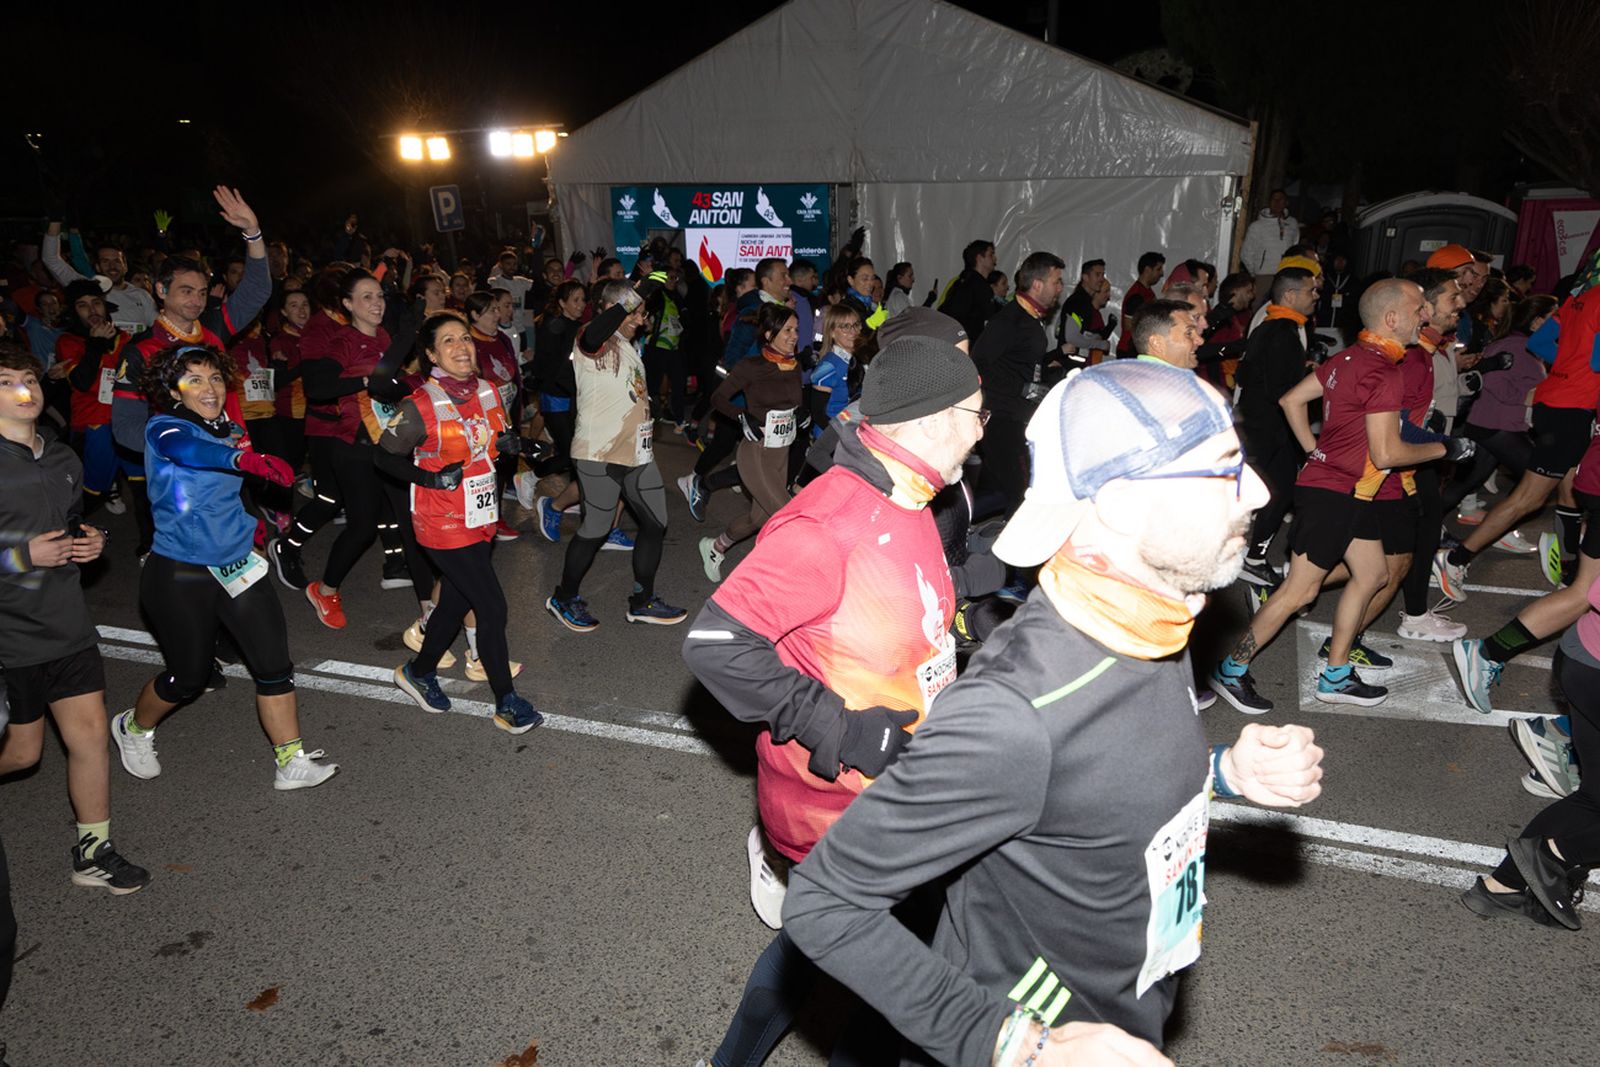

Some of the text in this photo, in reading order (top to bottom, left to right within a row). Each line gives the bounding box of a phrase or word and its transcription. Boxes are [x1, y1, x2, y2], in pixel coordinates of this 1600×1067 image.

[438, 191, 456, 225] P
[692, 192, 744, 208] 43 SAN
[660, 209, 670, 221] 43
[688, 204, 742, 224] ANTÓN
[764, 209, 775, 221] 43
[739, 245, 764, 256] SAN
[927, 679, 941, 698] SAN
[1175, 815, 1200, 850] NOCHE
[1164, 856, 1184, 888] SAN
